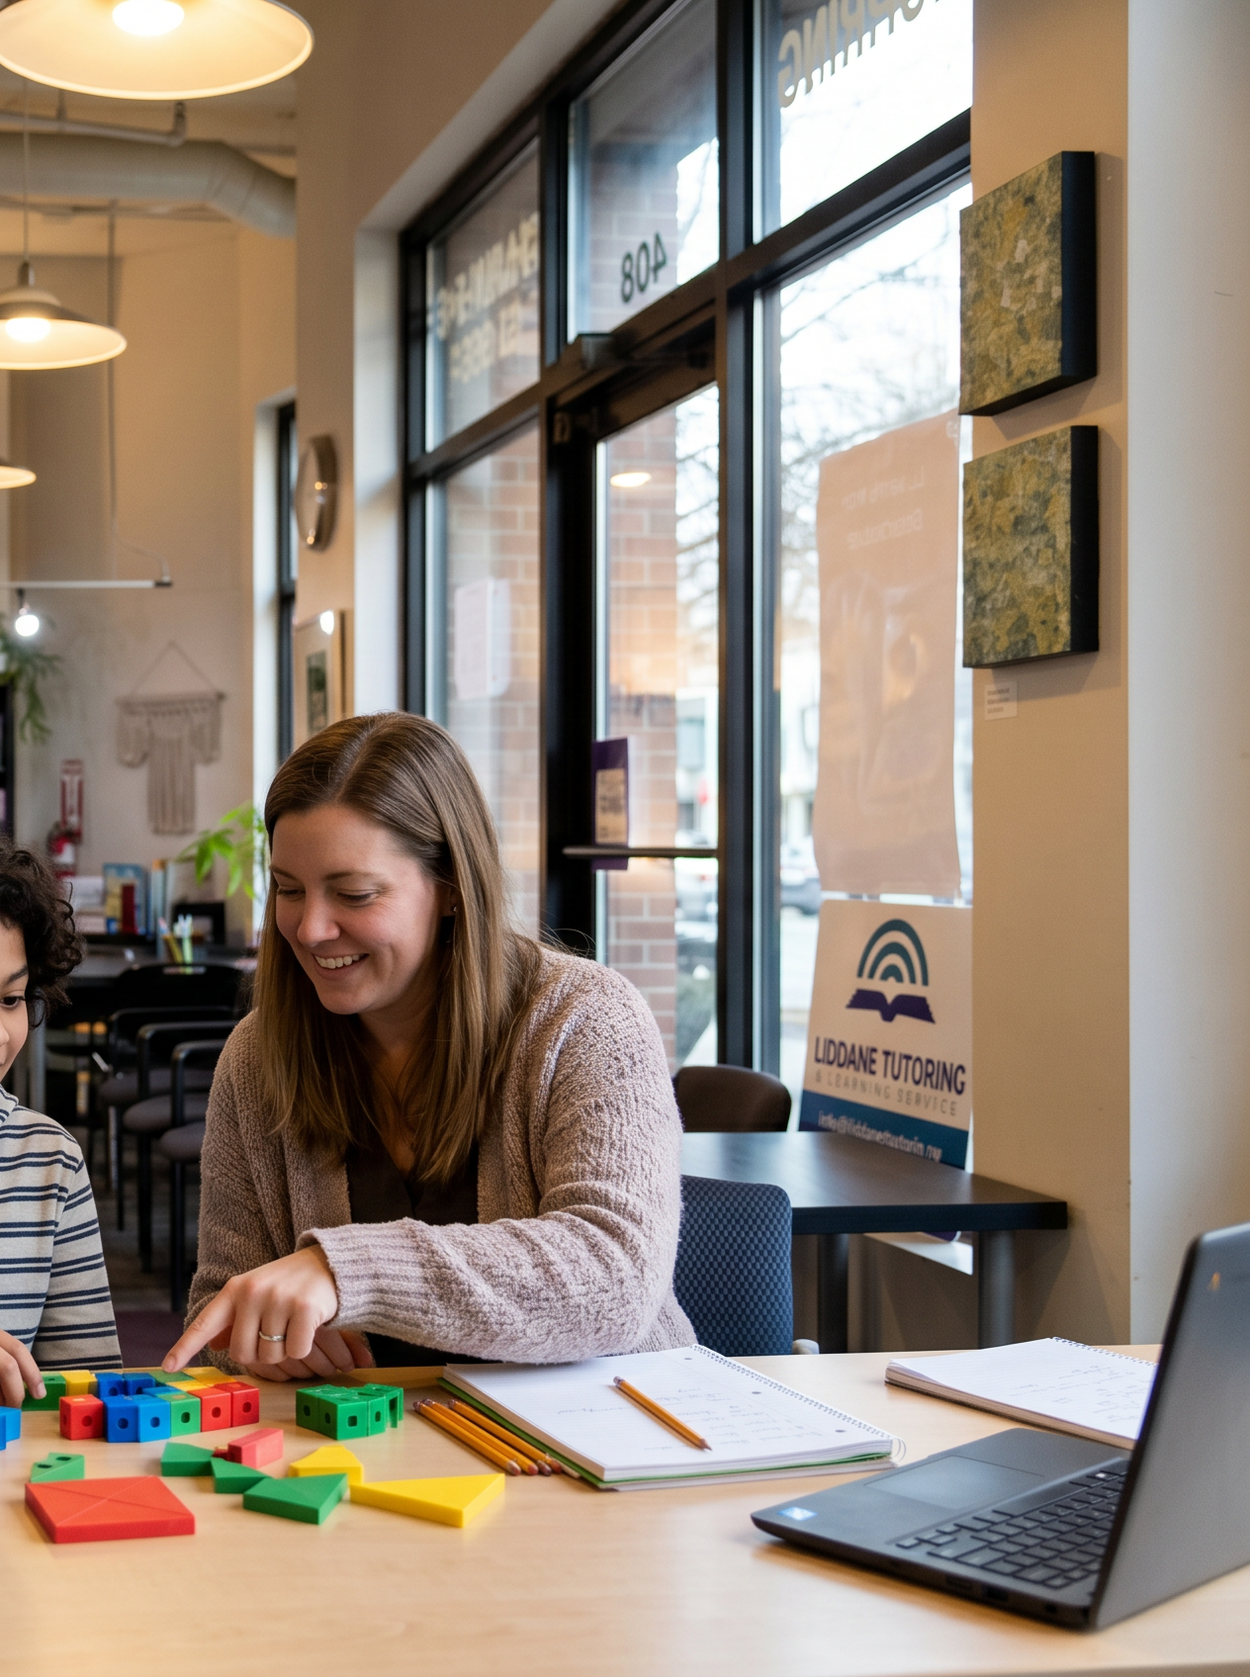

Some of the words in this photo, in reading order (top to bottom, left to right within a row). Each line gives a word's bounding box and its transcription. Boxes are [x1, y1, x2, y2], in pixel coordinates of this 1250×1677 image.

[814, 1036, 878, 1075] LIDDANE
[882, 1049, 966, 1095] TUTORING
[827, 1071, 891, 1100] LEARNING
[897, 1088, 958, 1116] SERVICE
